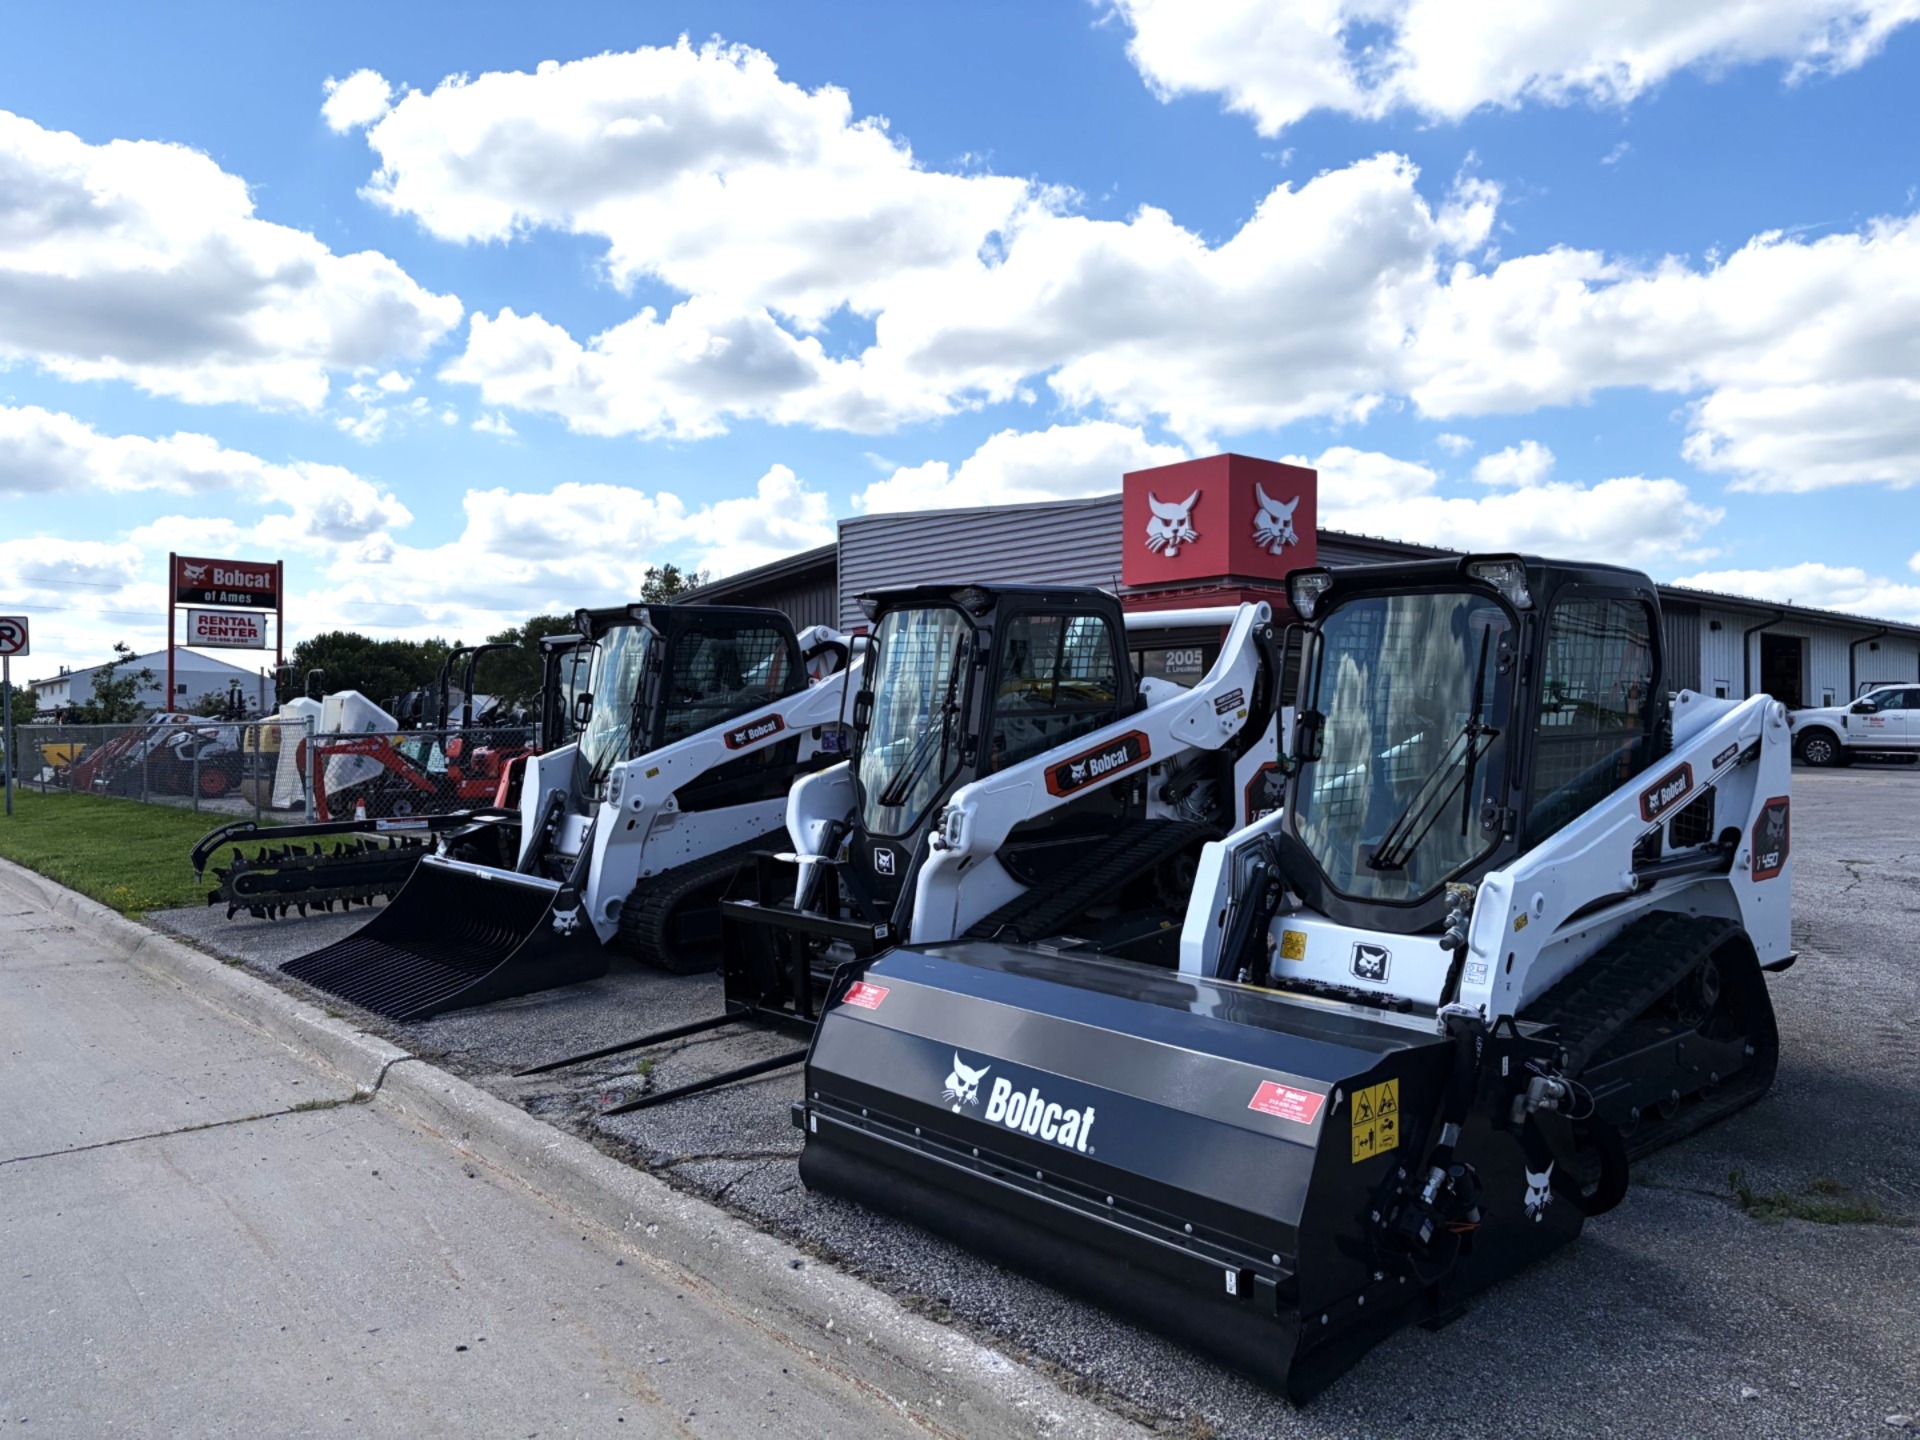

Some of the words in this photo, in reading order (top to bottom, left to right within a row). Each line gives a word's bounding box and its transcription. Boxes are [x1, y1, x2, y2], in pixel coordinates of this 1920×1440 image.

[213, 568, 271, 588] Bobcat
[204, 591, 216, 601] of
[220, 591, 252, 604] Ames
[198, 615, 256, 627] RENTAL
[197, 626, 258, 638] CENTER
[1166, 650, 1203, 666] 2005
[748, 721, 777, 740] Bobcat
[1089, 745, 1129, 776] Bobcat
[1661, 773, 1688, 806] Bobcat
[1757, 851, 1779, 871] T450
[985, 1076, 1096, 1153] Bobcat
